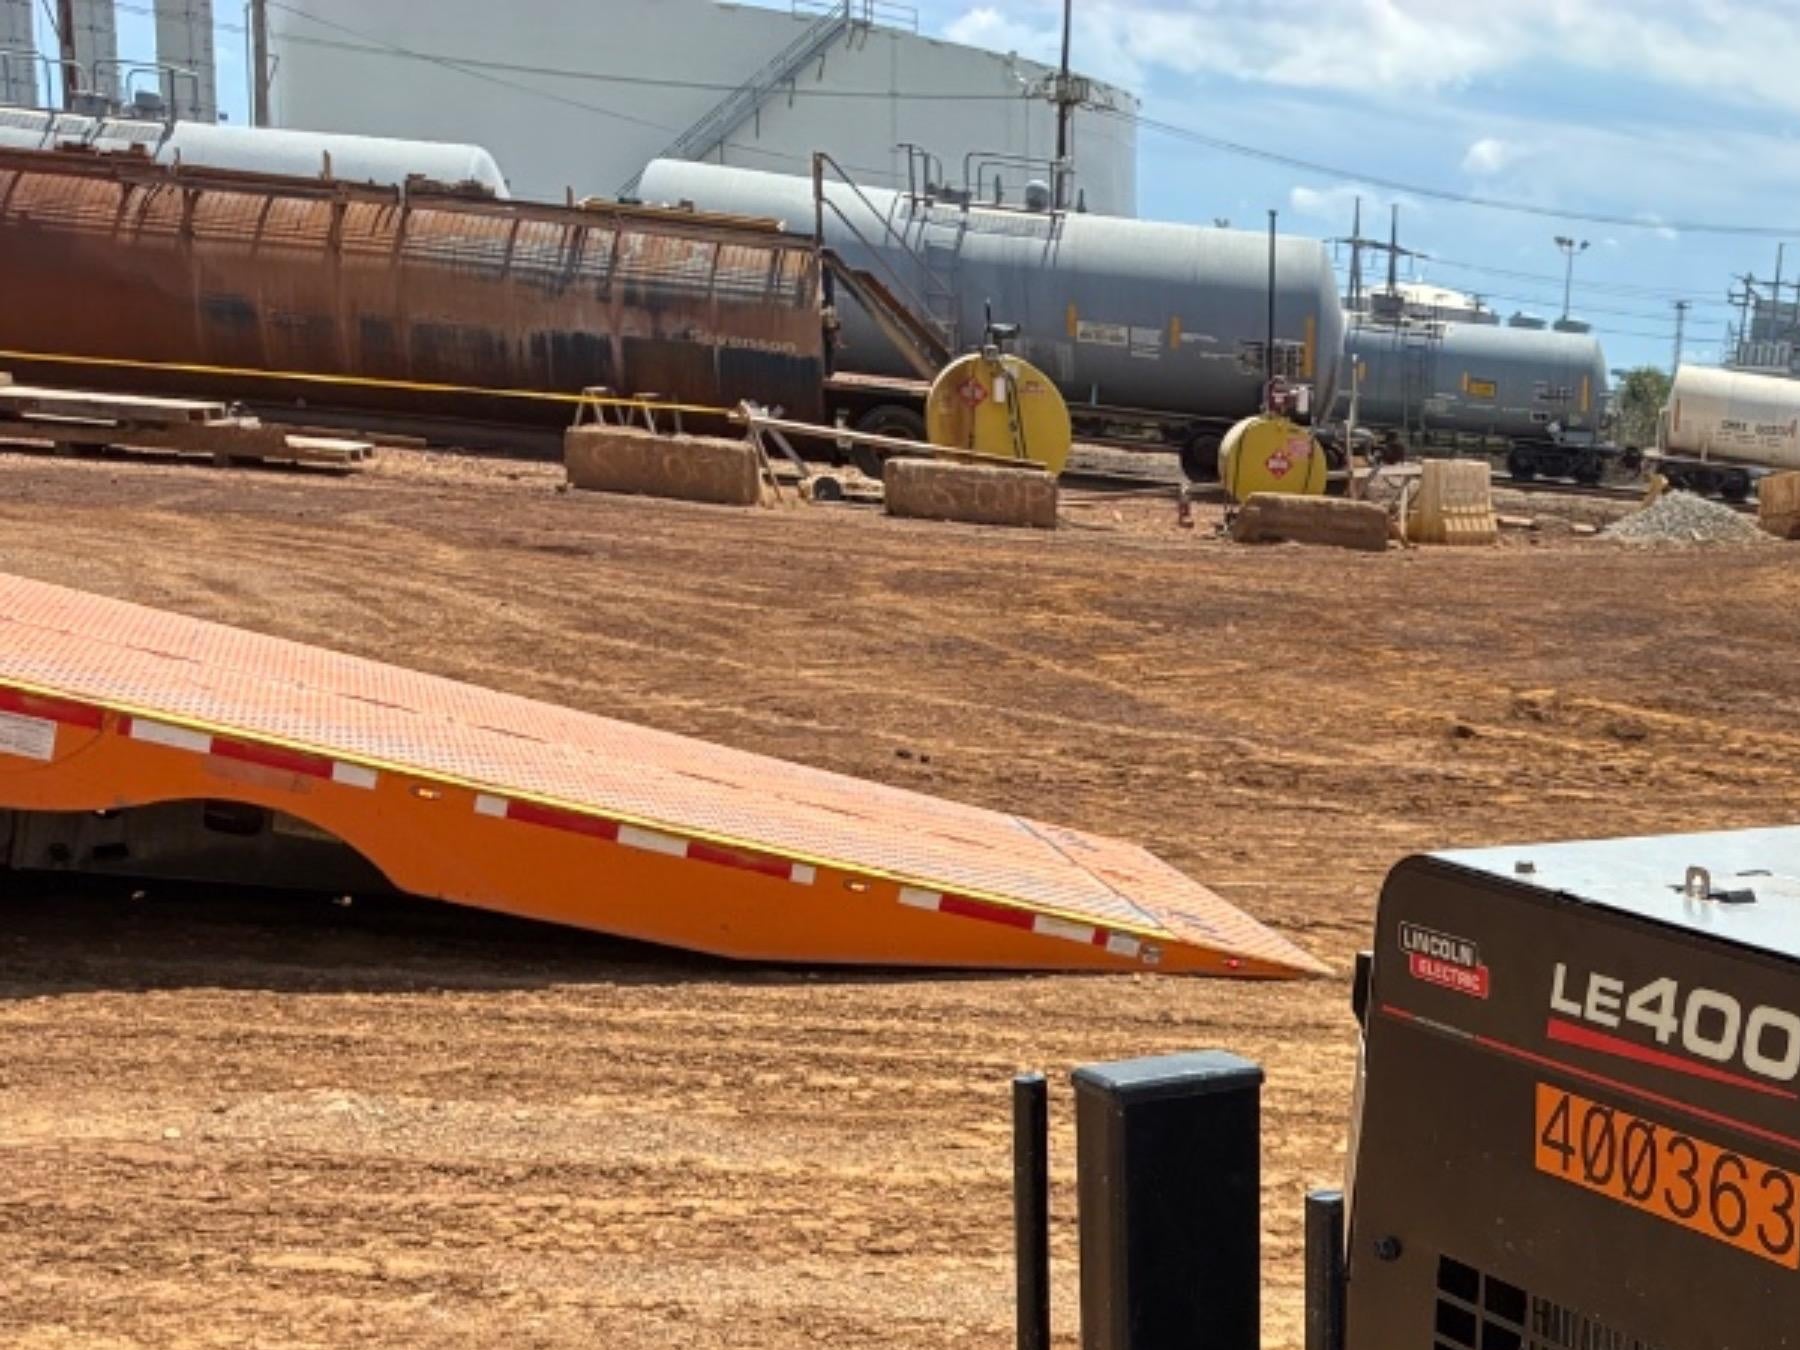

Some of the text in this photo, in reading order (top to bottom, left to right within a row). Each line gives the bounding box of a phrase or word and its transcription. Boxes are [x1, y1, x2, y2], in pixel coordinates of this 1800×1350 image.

[1402, 927, 1474, 966] LINCOLN
[1418, 958, 1481, 991] ELECTRIC
[1541, 1094, 1796, 1256] 400363
